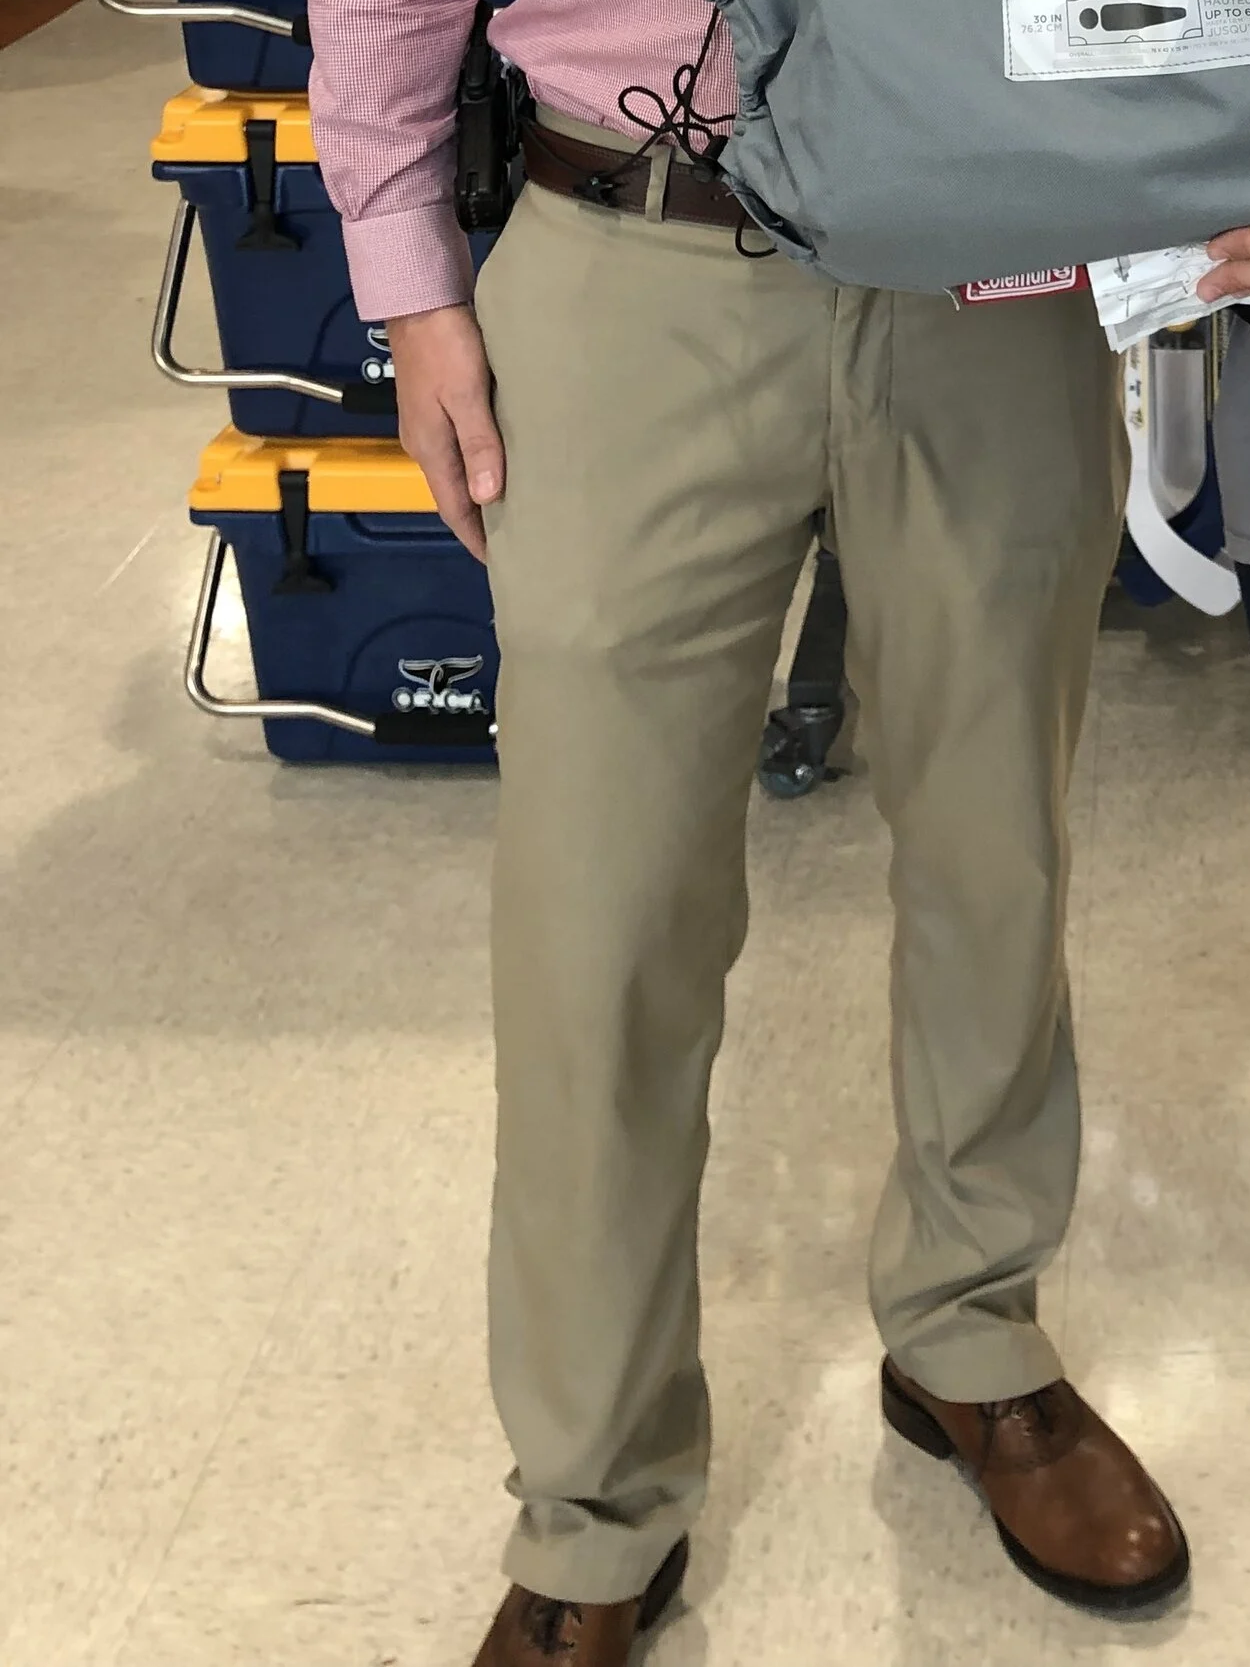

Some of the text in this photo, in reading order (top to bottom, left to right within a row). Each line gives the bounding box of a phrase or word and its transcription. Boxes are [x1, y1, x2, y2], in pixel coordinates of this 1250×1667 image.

[1033, 14, 1062, 24] 30 IN
[1204, 9, 1222, 20] UP
[1224, 8, 1242, 17] TO
[1021, 23, 1063, 33] 76.2 CM
[392, 687, 488, 715] ORCA
